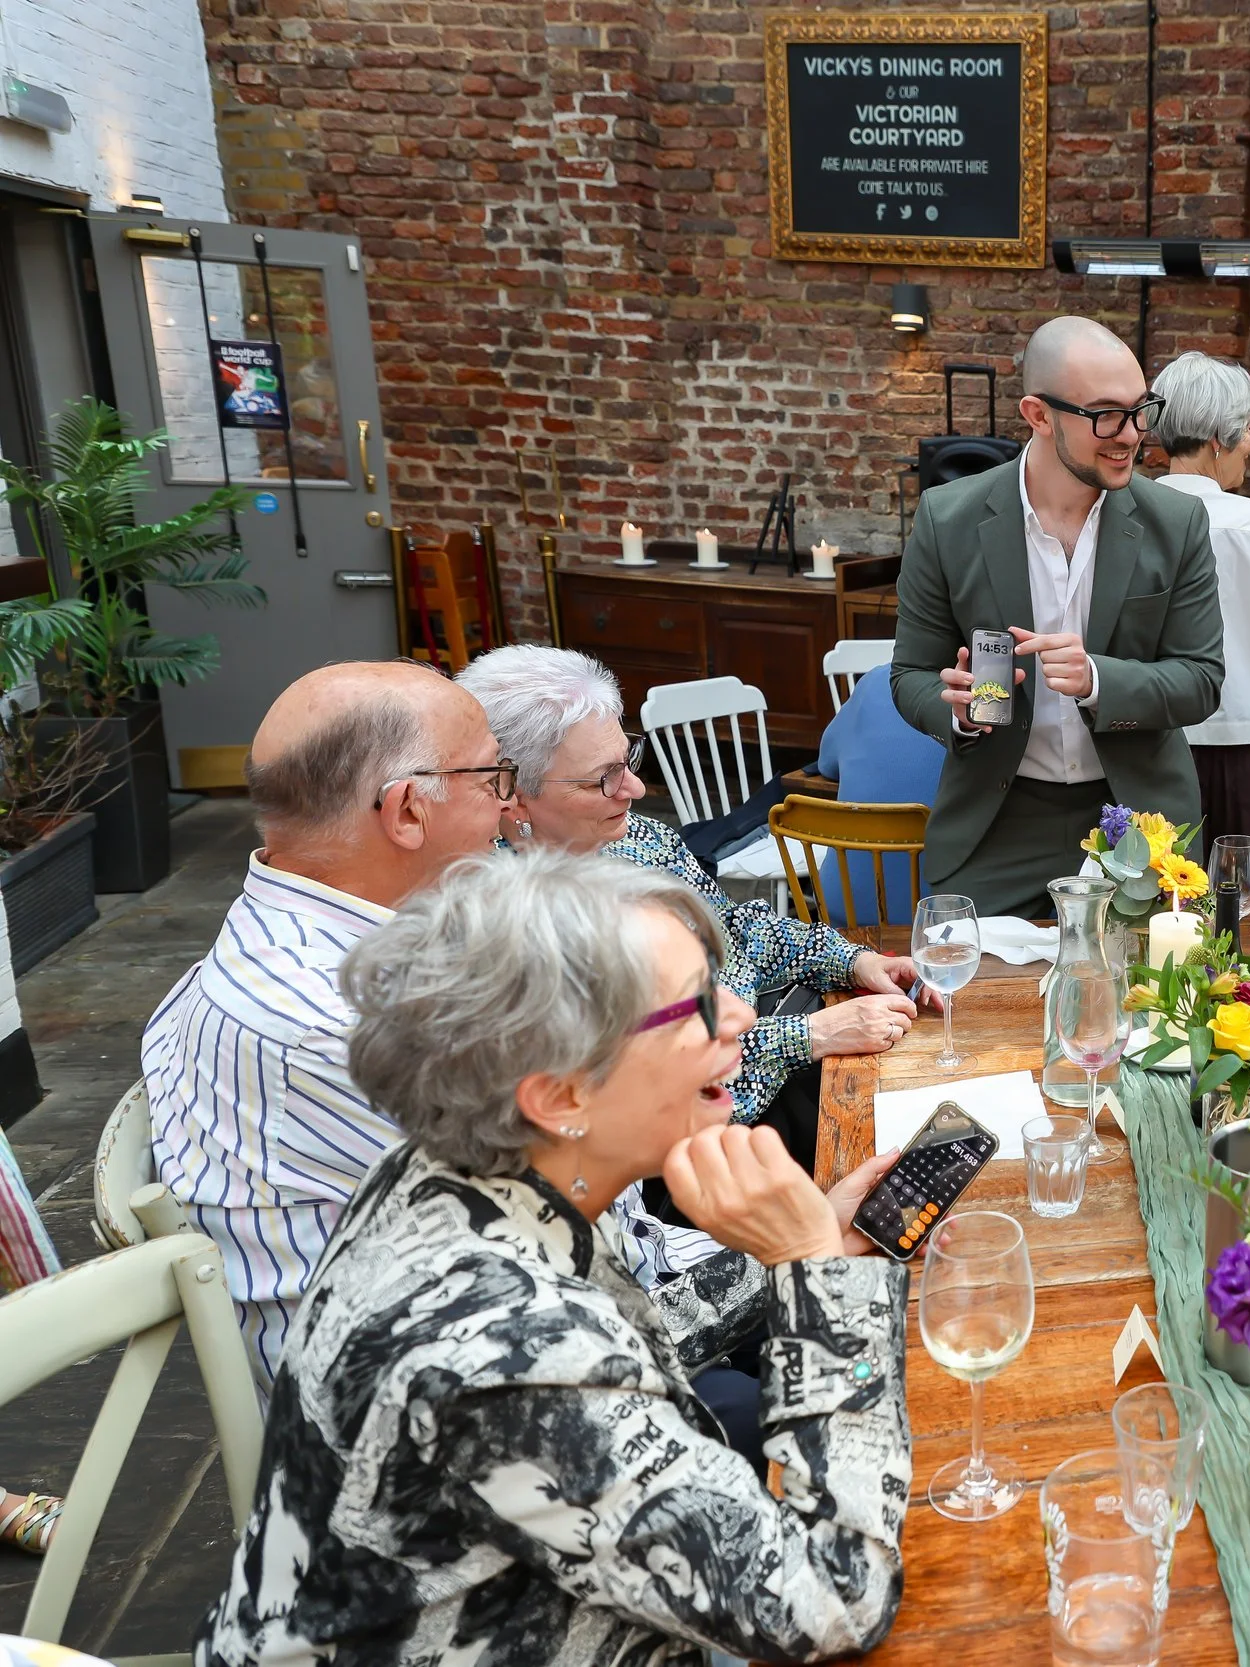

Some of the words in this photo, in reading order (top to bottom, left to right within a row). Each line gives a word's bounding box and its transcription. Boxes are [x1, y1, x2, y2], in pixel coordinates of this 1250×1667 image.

[804, 56, 873, 77] VICKY'S
[879, 58, 945, 77] DINING
[950, 58, 1003, 77] ROOM
[899, 87, 919, 99] OUR
[856, 105, 958, 124] VICTORIAN
[849, 129, 964, 147] COURTYARD
[821, 157, 840, 171] ARE
[843, 158, 896, 173] AVAILABLE
[899, 159, 919, 173] FOR
[921, 159, 963, 173] PRIVATE
[965, 160, 988, 174] HIRE
[858, 181, 885, 195] COME
[887, 181, 913, 195] TALK
[915, 182, 930, 196] TO
[222, 355, 251, 365] world
[253, 357, 274, 367] cup
[977, 642, 1008, 655] 14:53
[950, 1142, 979, 1167] 351,453
